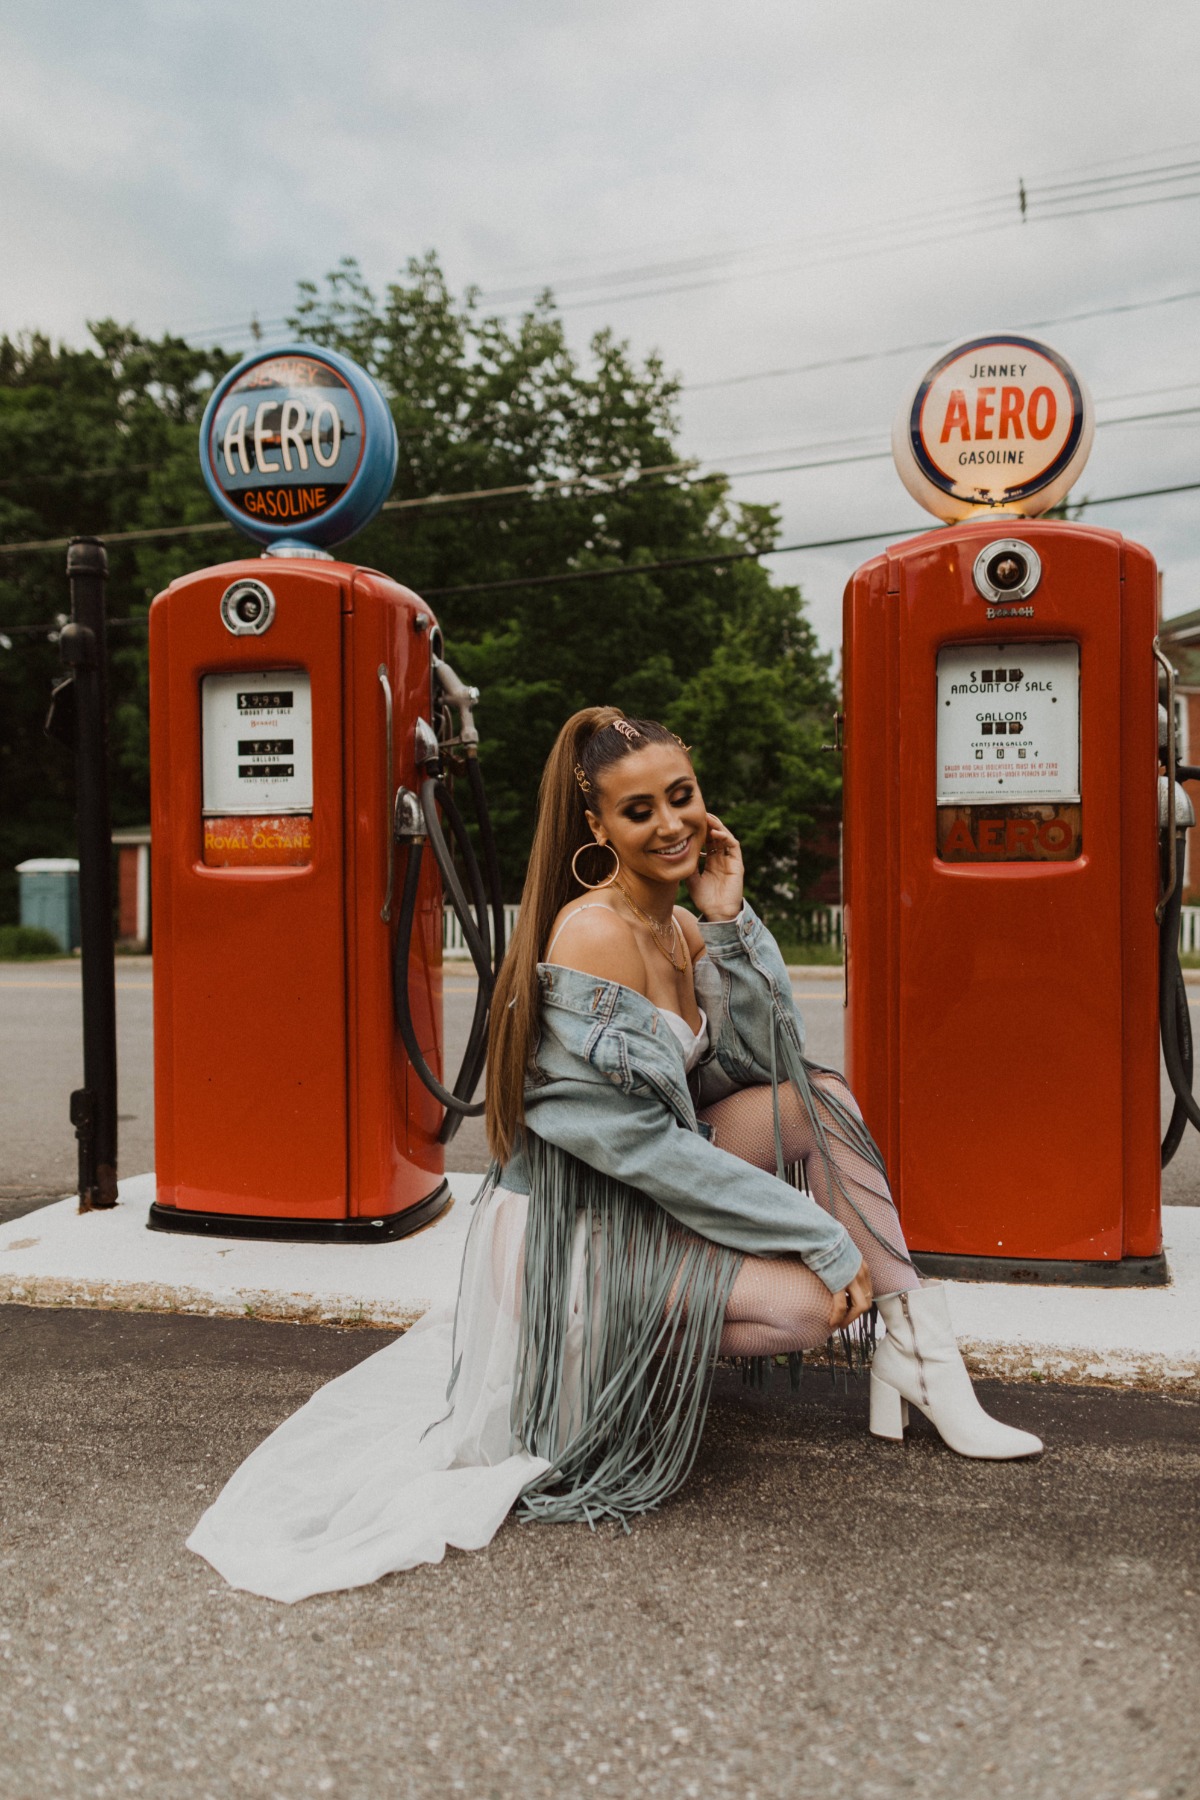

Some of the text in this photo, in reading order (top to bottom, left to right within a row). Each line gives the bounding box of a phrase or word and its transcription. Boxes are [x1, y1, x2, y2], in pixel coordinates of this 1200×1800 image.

[970, 364, 1027, 378] JENNEY
[940, 386, 1057, 444] AERO
[223, 400, 341, 476] AERO
[958, 451, 1024, 466] GASOLINE
[244, 488, 327, 517] GASOLINE
[951, 682, 1052, 694] AMOUNT OF SALE
[976, 712, 1028, 722] GALLONS
[204, 832, 310, 849] ROYAL OCTANE
[942, 820, 1072, 853] AERO
